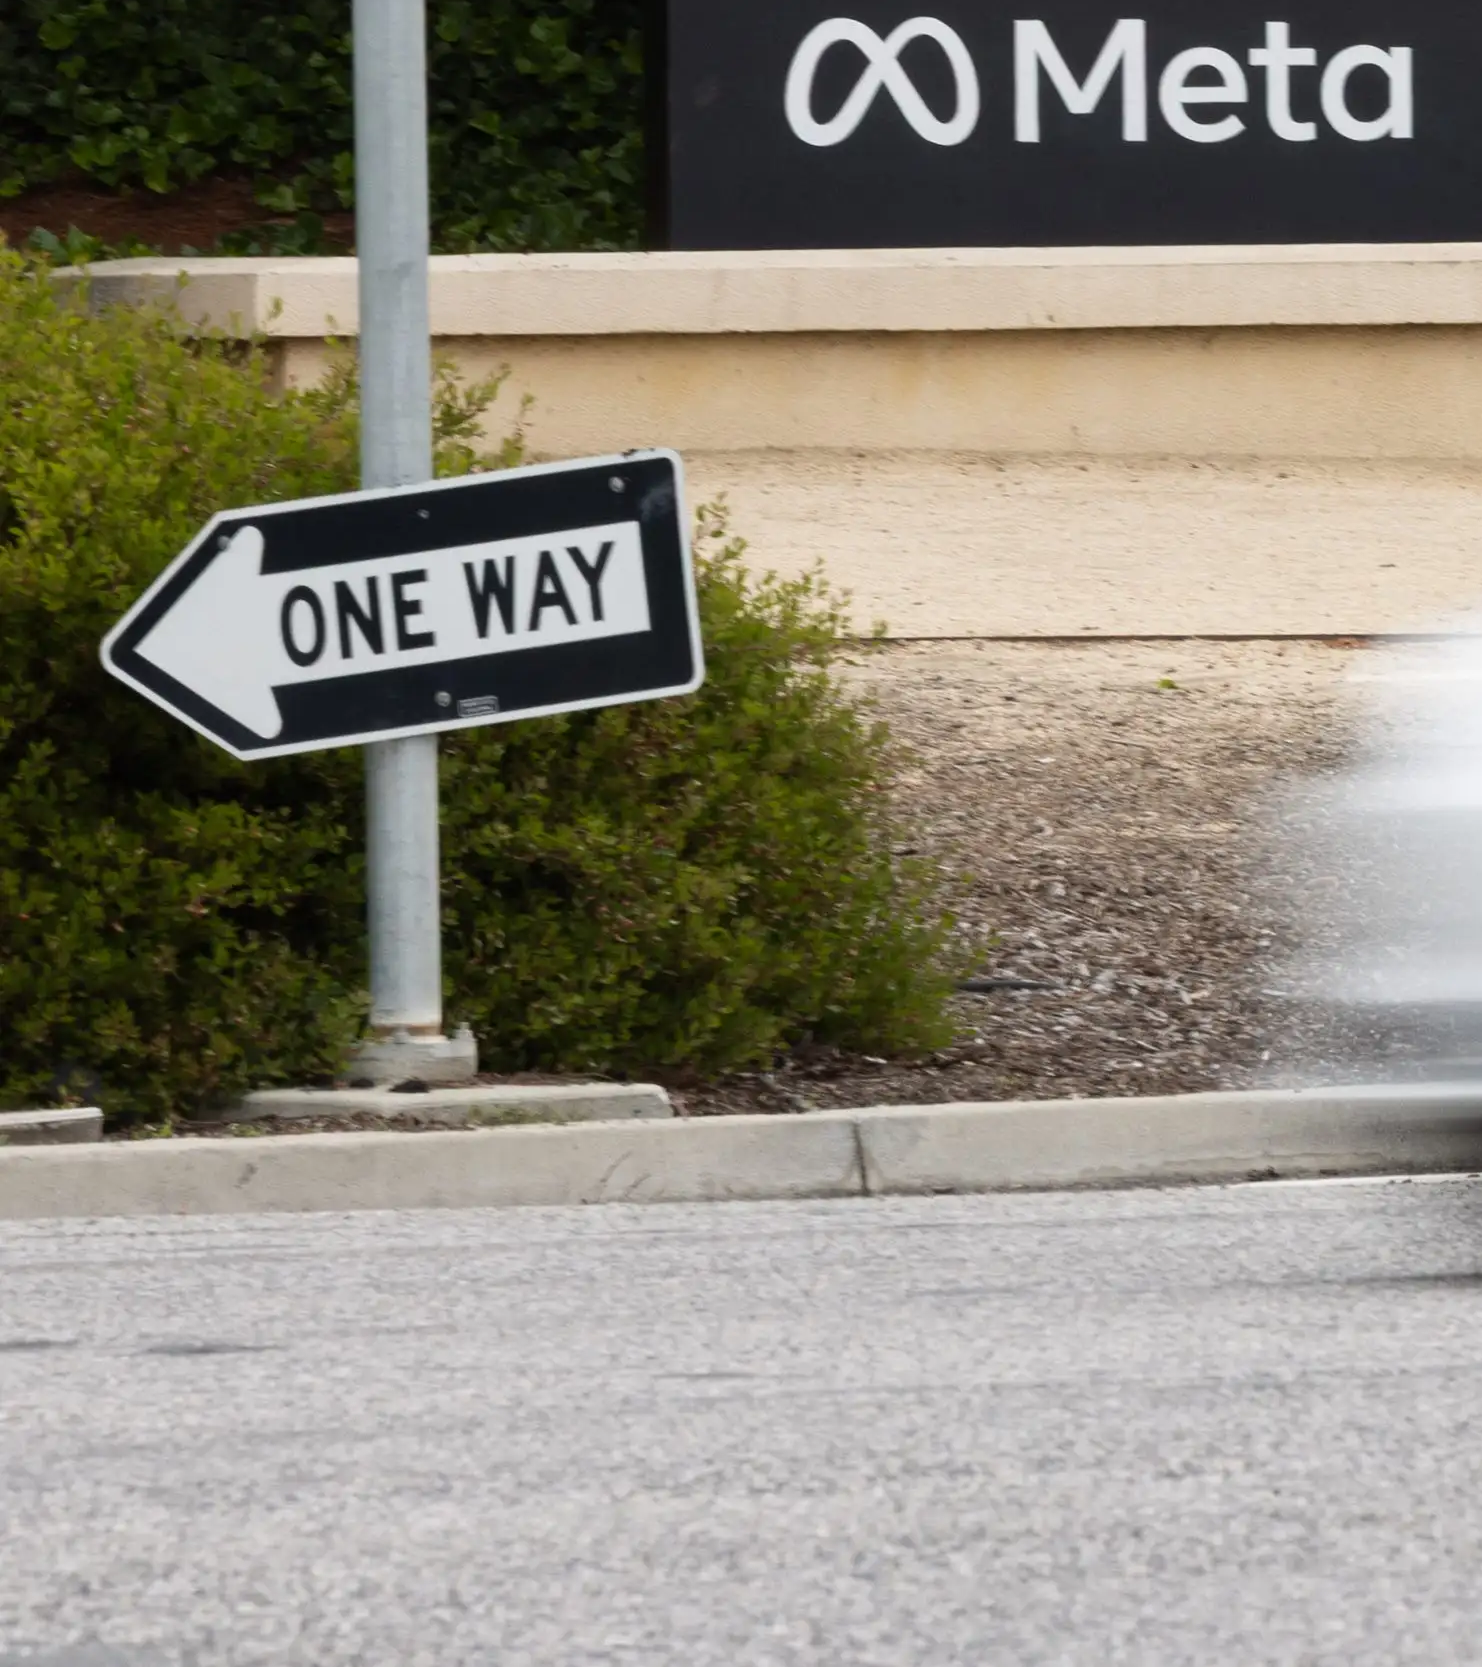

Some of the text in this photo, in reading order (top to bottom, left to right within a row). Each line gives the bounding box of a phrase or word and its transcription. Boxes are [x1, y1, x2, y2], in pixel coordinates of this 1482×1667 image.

[1013, 17, 1414, 144] Meta
[279, 540, 614, 669] ONE WAY
